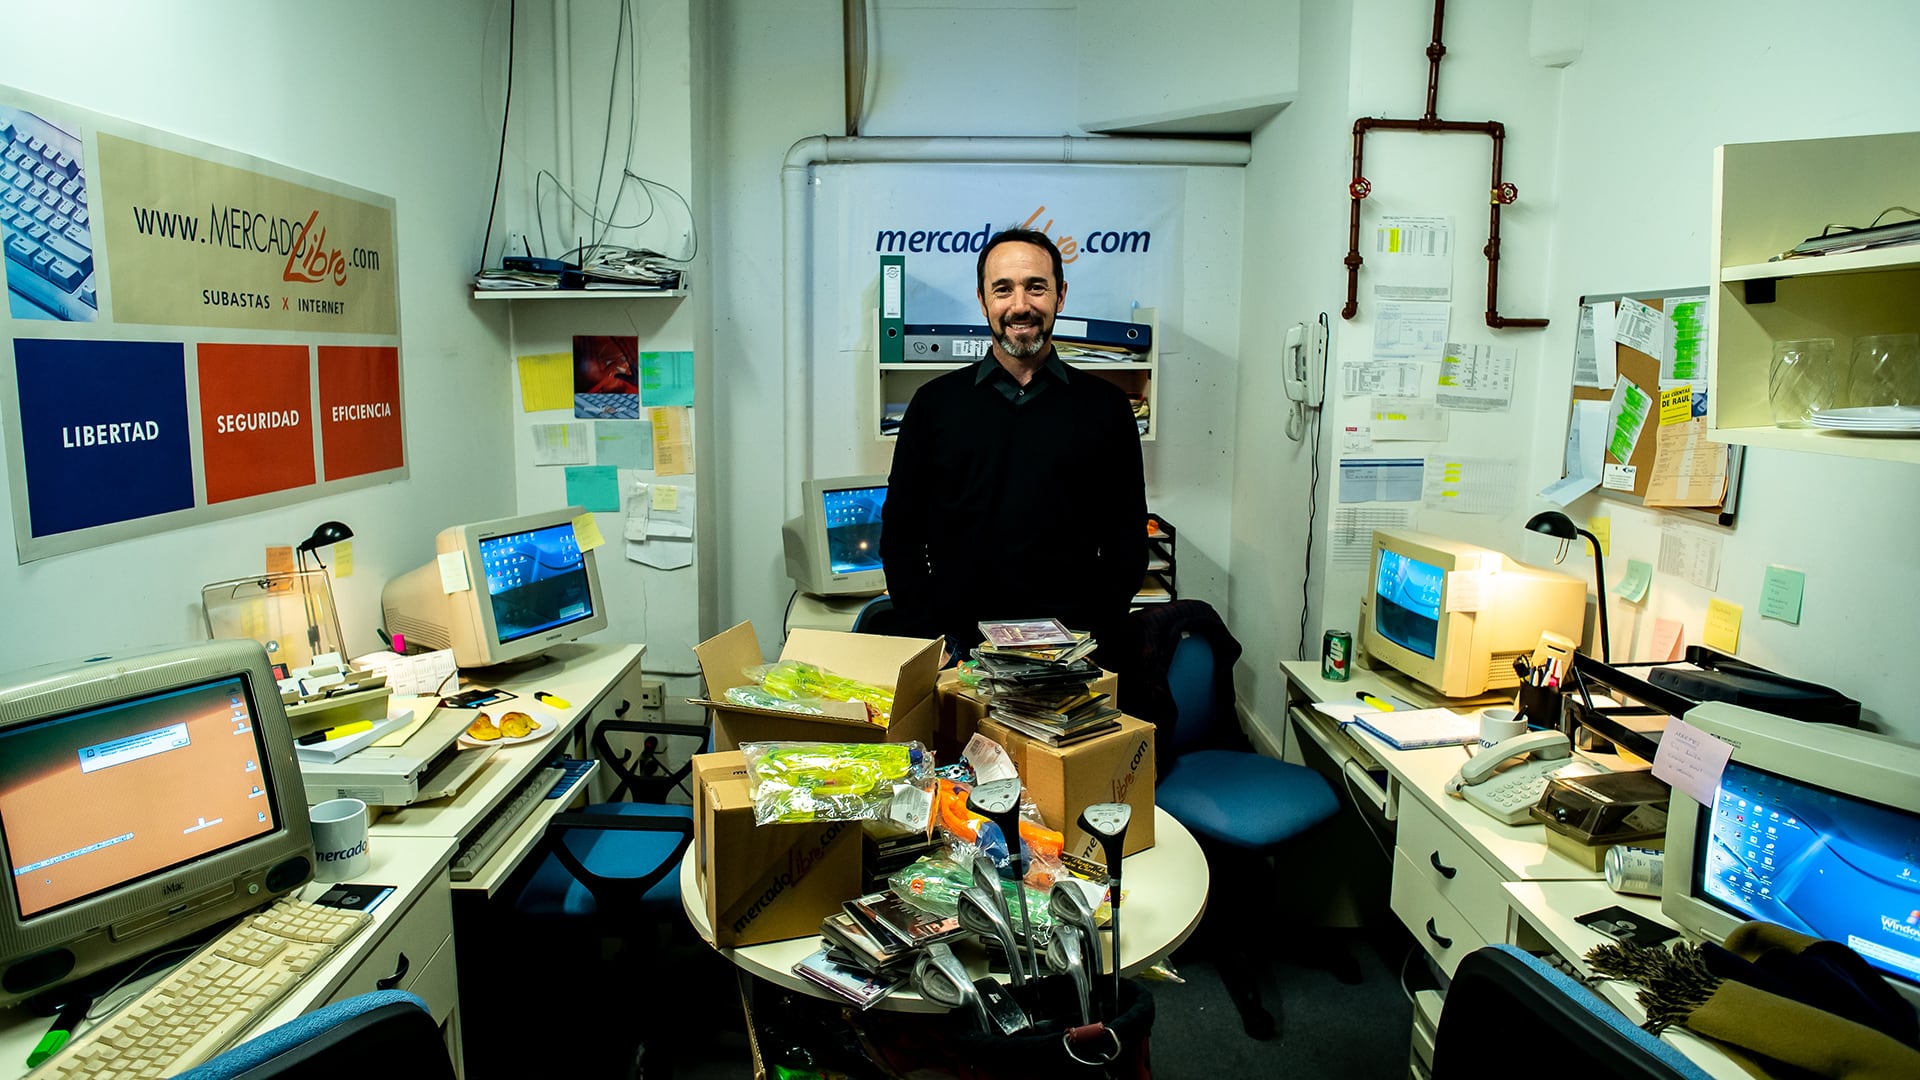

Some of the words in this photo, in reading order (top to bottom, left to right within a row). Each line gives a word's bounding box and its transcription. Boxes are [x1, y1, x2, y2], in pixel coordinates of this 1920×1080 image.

[133, 202, 380, 286] www.MERCADOLibre.com
[876, 205, 1151, 264] mercadre.com
[202, 289, 271, 309] SUBASTAS
[282, 296, 289, 310] X
[298, 298, 345, 315] INTERNET
[332, 402, 391, 422] EFICIENCIA
[1662, 400, 1670, 408] DE
[1672, 395, 1690, 405] RAUL
[63, 420, 159, 448] LIBERTAD
[217, 409, 300, 434] SEGURIDAD
[315, 838, 369, 862] mercado
[163, 879, 185, 895] iMac
